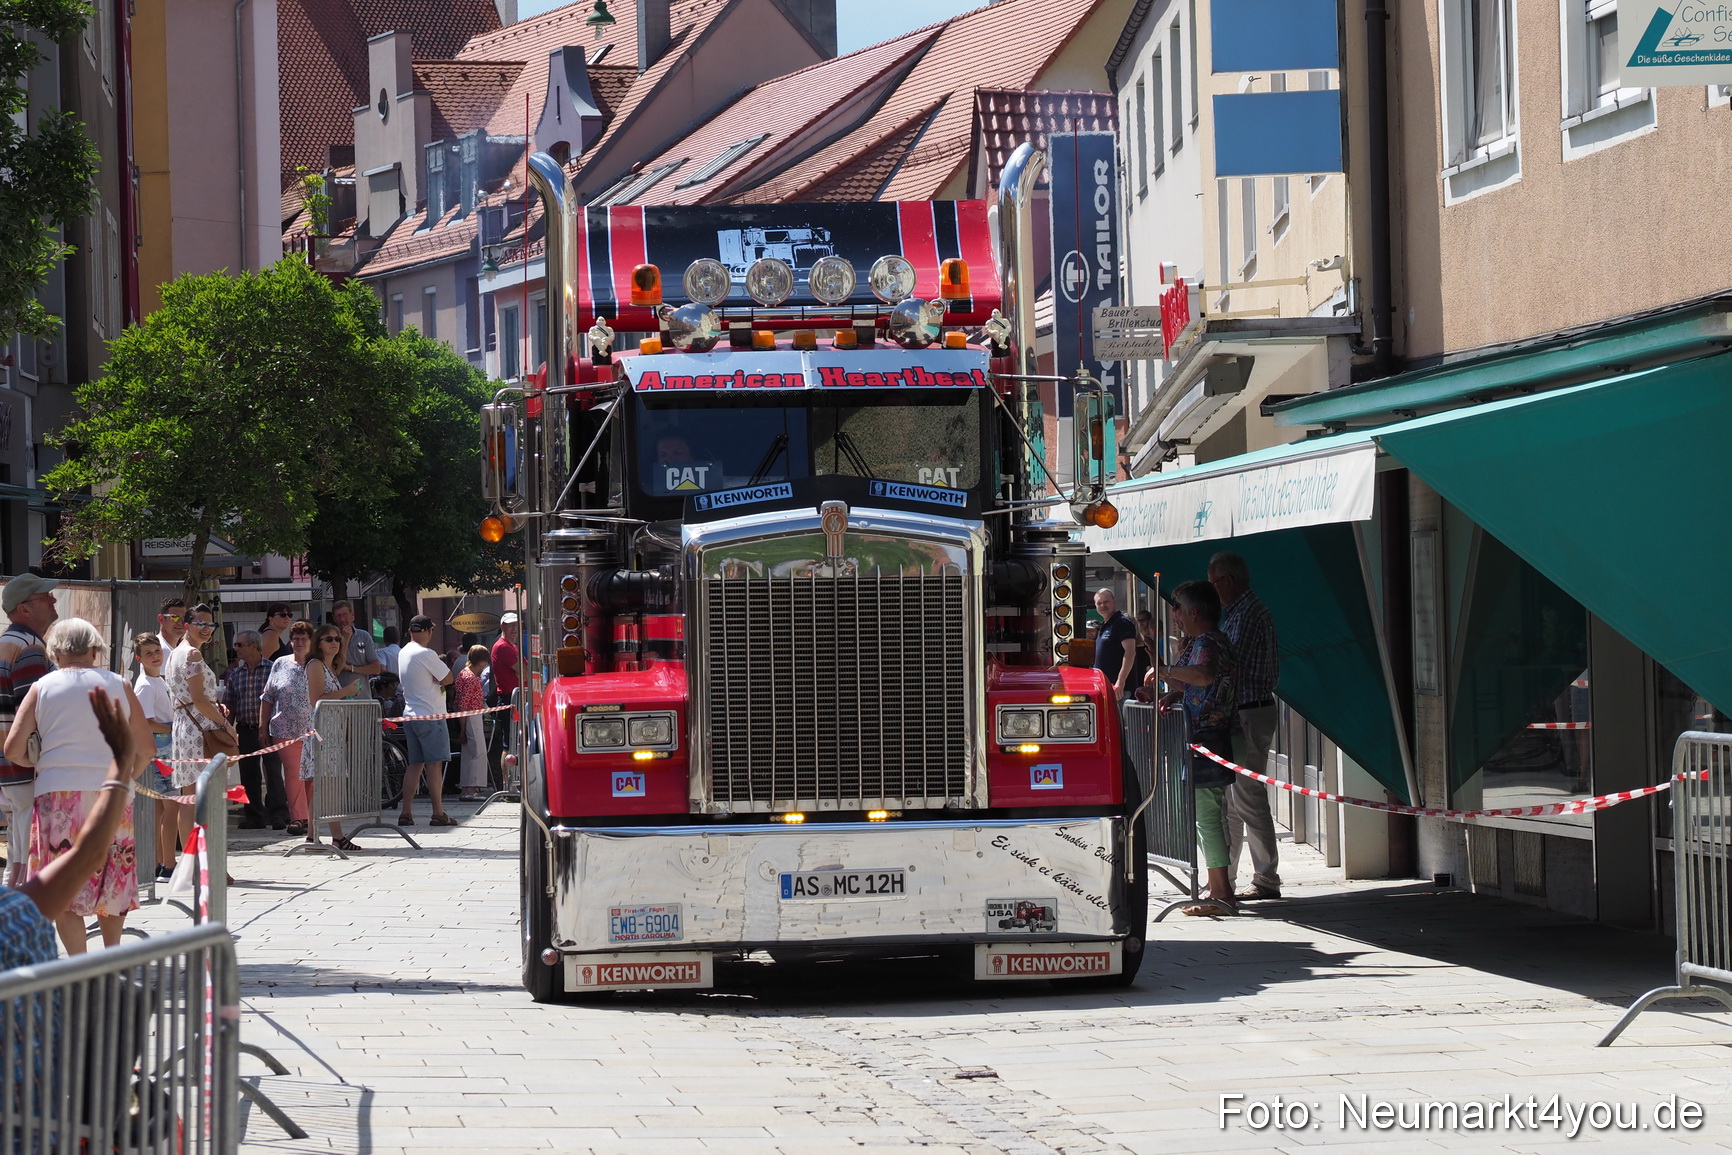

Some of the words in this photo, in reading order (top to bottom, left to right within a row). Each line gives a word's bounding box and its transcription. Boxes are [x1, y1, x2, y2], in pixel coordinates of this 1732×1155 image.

[1637, 55, 1651, 64] Die
[1652, 54, 1673, 63] süße
[1674, 53, 1731, 63] Geschenkidee
[1093, 158, 1112, 291] TAILOR
[1101, 306, 1139, 318] Bauer's
[635, 369, 806, 391] American
[817, 366, 986, 387] Heartbeat
[666, 466, 709, 491] CAT
[918, 467, 960, 489] CAT
[714, 485, 790, 506] KENWORTH
[889, 484, 965, 504] KENWORTH
[1238, 472, 1250, 523] Die
[1272, 457, 1338, 518] Geschenkidee
[615, 776, 642, 792] CAT
[1033, 768, 1059, 784] CAT
[991, 835, 1011, 851] Ei
[1010, 849, 1040, 868] sink
[1038, 866, 1053, 876] ei
[1052, 872, 1085, 896] kään
[793, 876, 820, 897] AS
[833, 874, 861, 896] MC
[865, 873, 904, 894] 12H
[611, 914, 679, 935] EWB-6904
[641, 932, 676, 940] CAROLINA
[600, 965, 697, 982] KENWORTH
[1010, 955, 1107, 972] KENWORTH
